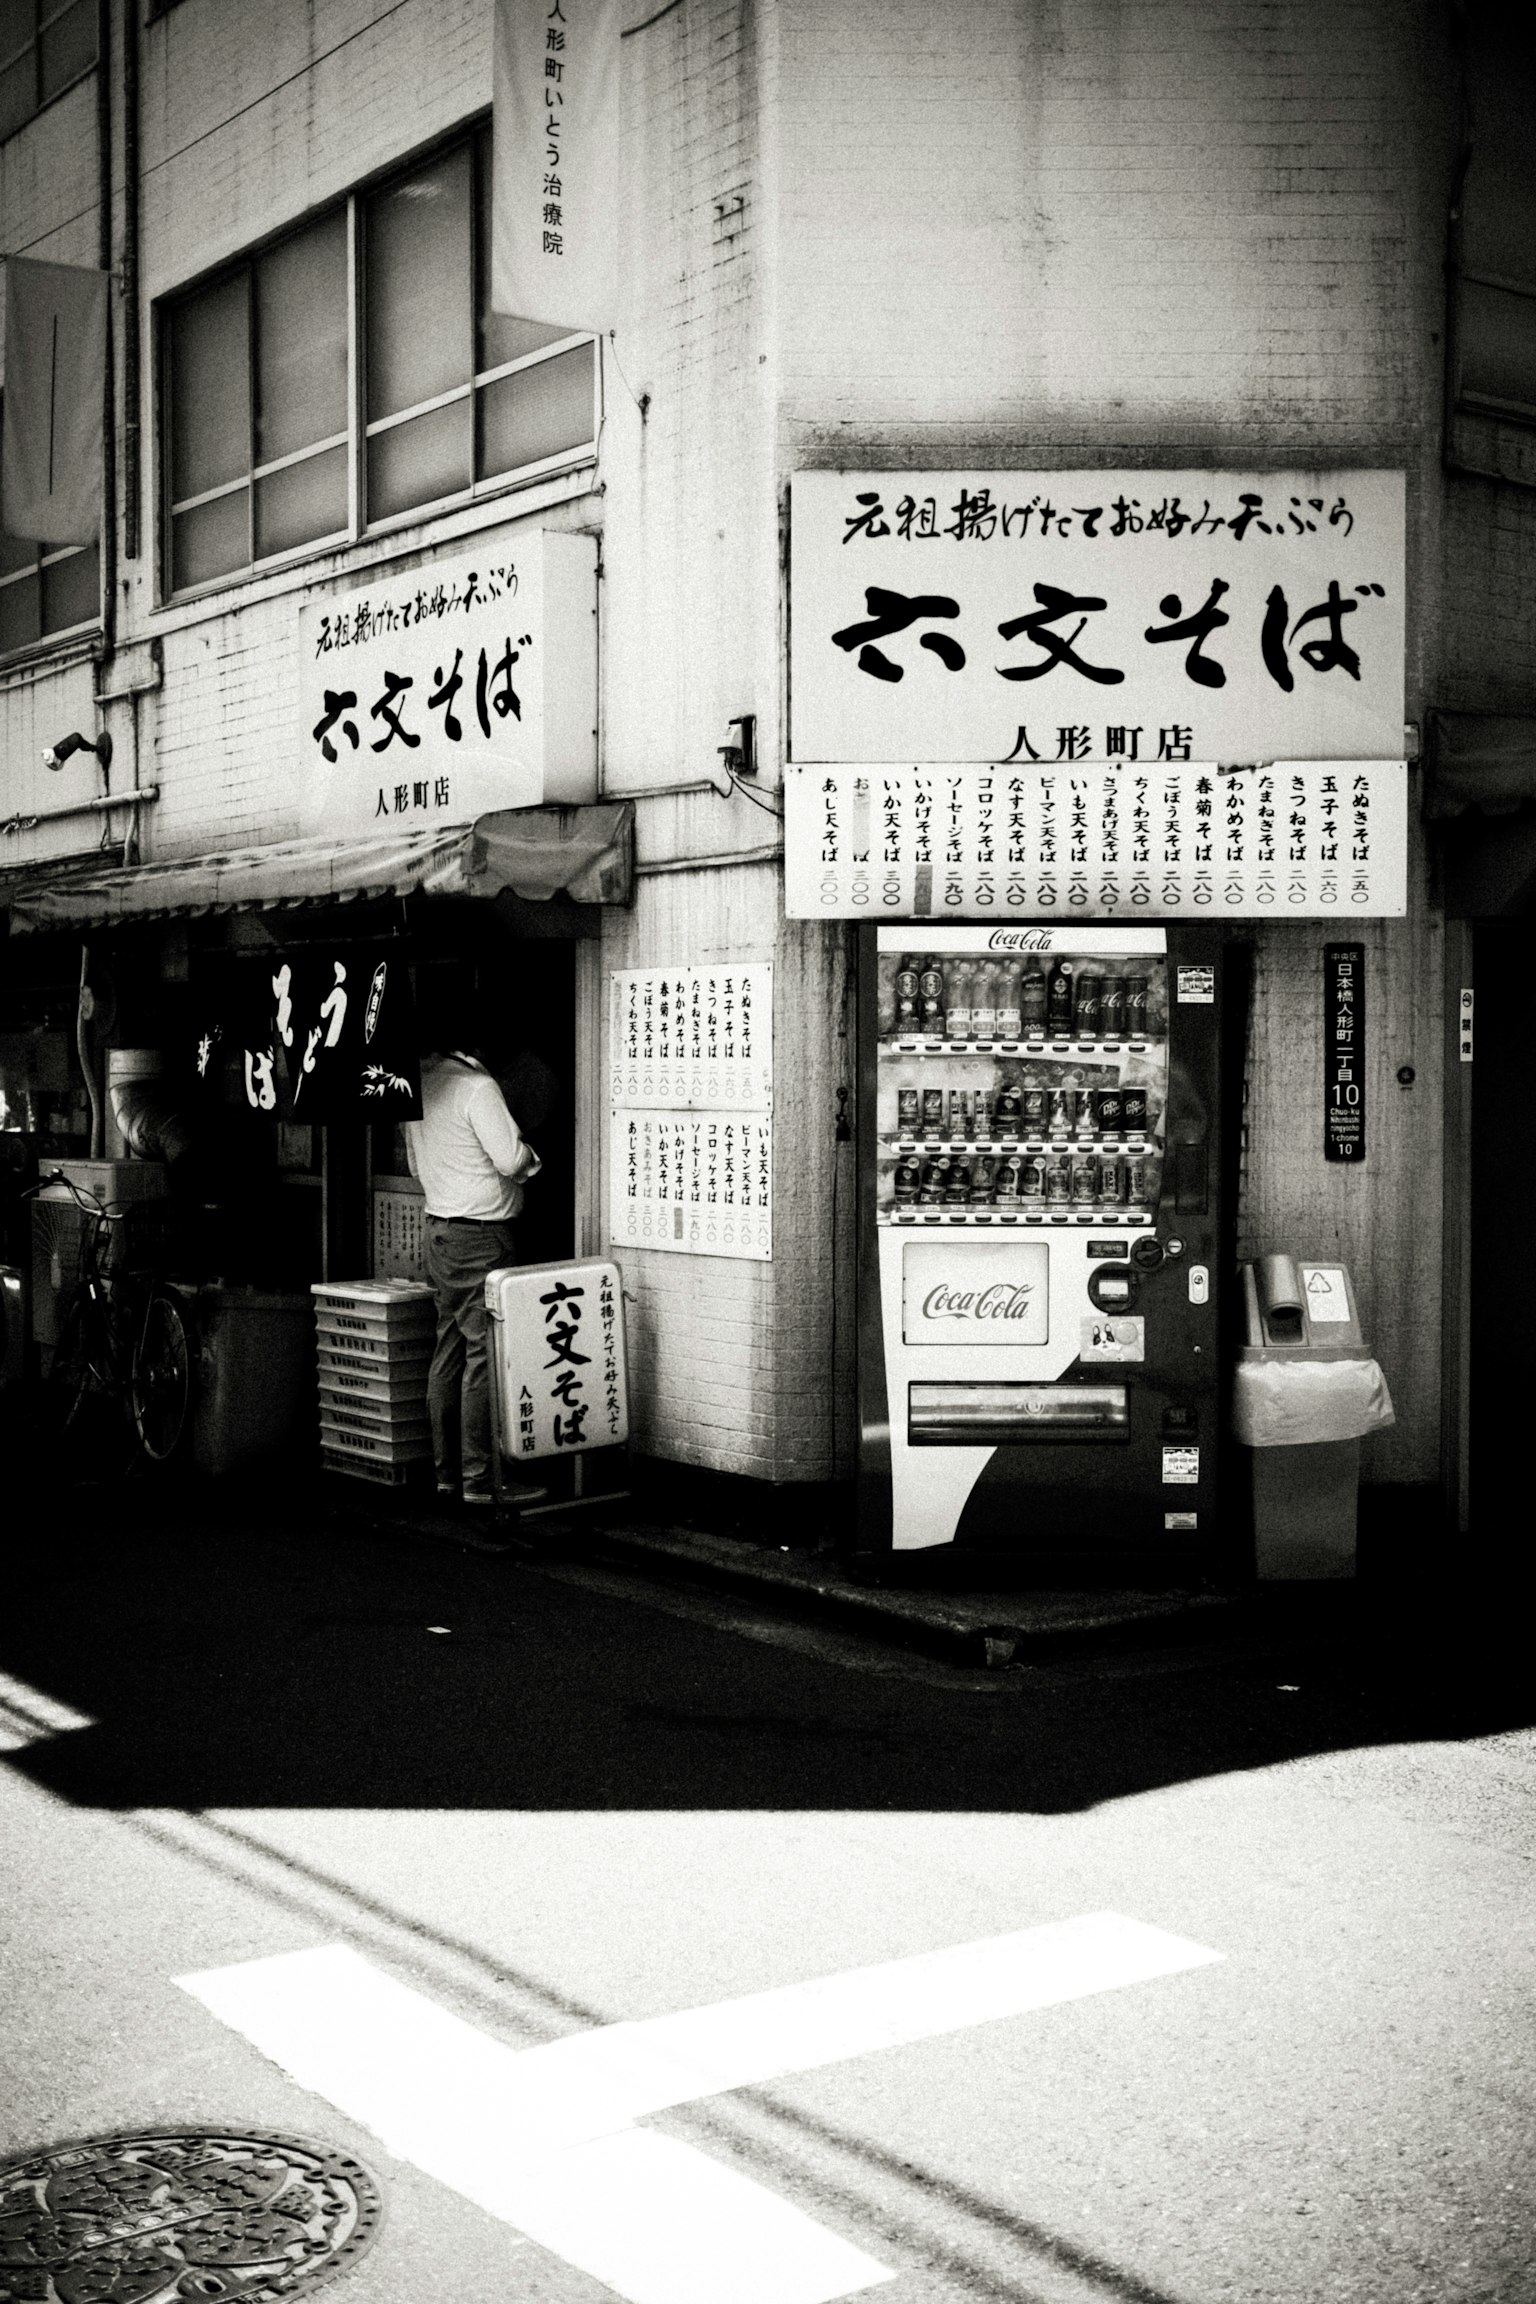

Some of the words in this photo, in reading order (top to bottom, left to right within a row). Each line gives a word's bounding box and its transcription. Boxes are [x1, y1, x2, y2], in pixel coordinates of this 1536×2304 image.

[538, 0, 570, 255] 人形町いとう治療院
[843, 489, 1354, 544] 元祖揚げたてお好み天ぷら
[832, 578, 1386, 693] 六文そば
[313, 634, 532, 763] 六文そば
[1003, 725, 1193, 761] 人形町店
[376, 777, 449, 817] 人形町店
[884, 781, 901, 862] いか天そば
[915, 780, 932, 862] いかげそそば
[947, 778, 962, 862] ソーセージそば
[978, 779, 994, 862] コロッケそば
[1008, 778, 1026, 862] なす天そば
[1071, 780, 1088, 861] いも天そば
[1102, 777, 1119, 861] さつまあげ天そば
[1134, 777, 1150, 861] ちくわ天そば
[1164, 777, 1181, 861] ごぼう天そば
[1195, 777, 1213, 861] 春菊そば
[1226, 776, 1244, 861] わかめそば
[1258, 776, 1275, 861] たまねぎそば
[1290, 776, 1306, 860] きつねそば
[1320, 776, 1339, 860] 玉子そば
[1353, 775, 1369, 860] たぬきそば
[988, 929, 1055, 950] Coca-Cola
[1331, 952, 1359, 961] 中央区
[629, 983, 637, 1058] ちくわ天そば
[645, 982, 653, 1058] ごぼう天そば
[660, 982, 669, 1057] 春菊そば
[676, 982, 685, 1057] わかめそば
[692, 980, 700, 1057] たまねぎそば
[708, 980, 716, 1057] きつねそば
[724, 979, 733, 1057] 玉子そば
[742, 979, 751, 1057] たぬきそば
[1336, 963, 1354, 1082] 日本橋人形町一丁目
[1330, 1107, 1360, 1116] Chuo-ku
[1332, 1085, 1359, 1105] 10
[659, 1125, 668, 1198] いか天そば
[675, 1125, 684, 1200] いかげそそば
[692, 1124, 700, 1201] ソーセージそば
[708, 1125, 717, 1202] コロッケそば
[725, 1125, 734, 1203] なす天そば
[759, 1129, 768, 1206] いも天そば
[1339, 1143, 1353, 1155] 10
[922, 1284, 1035, 1319] Coca-Cola
[539, 1282, 592, 1446] 六文そば
[519, 1385, 535, 1452] 人形町店
